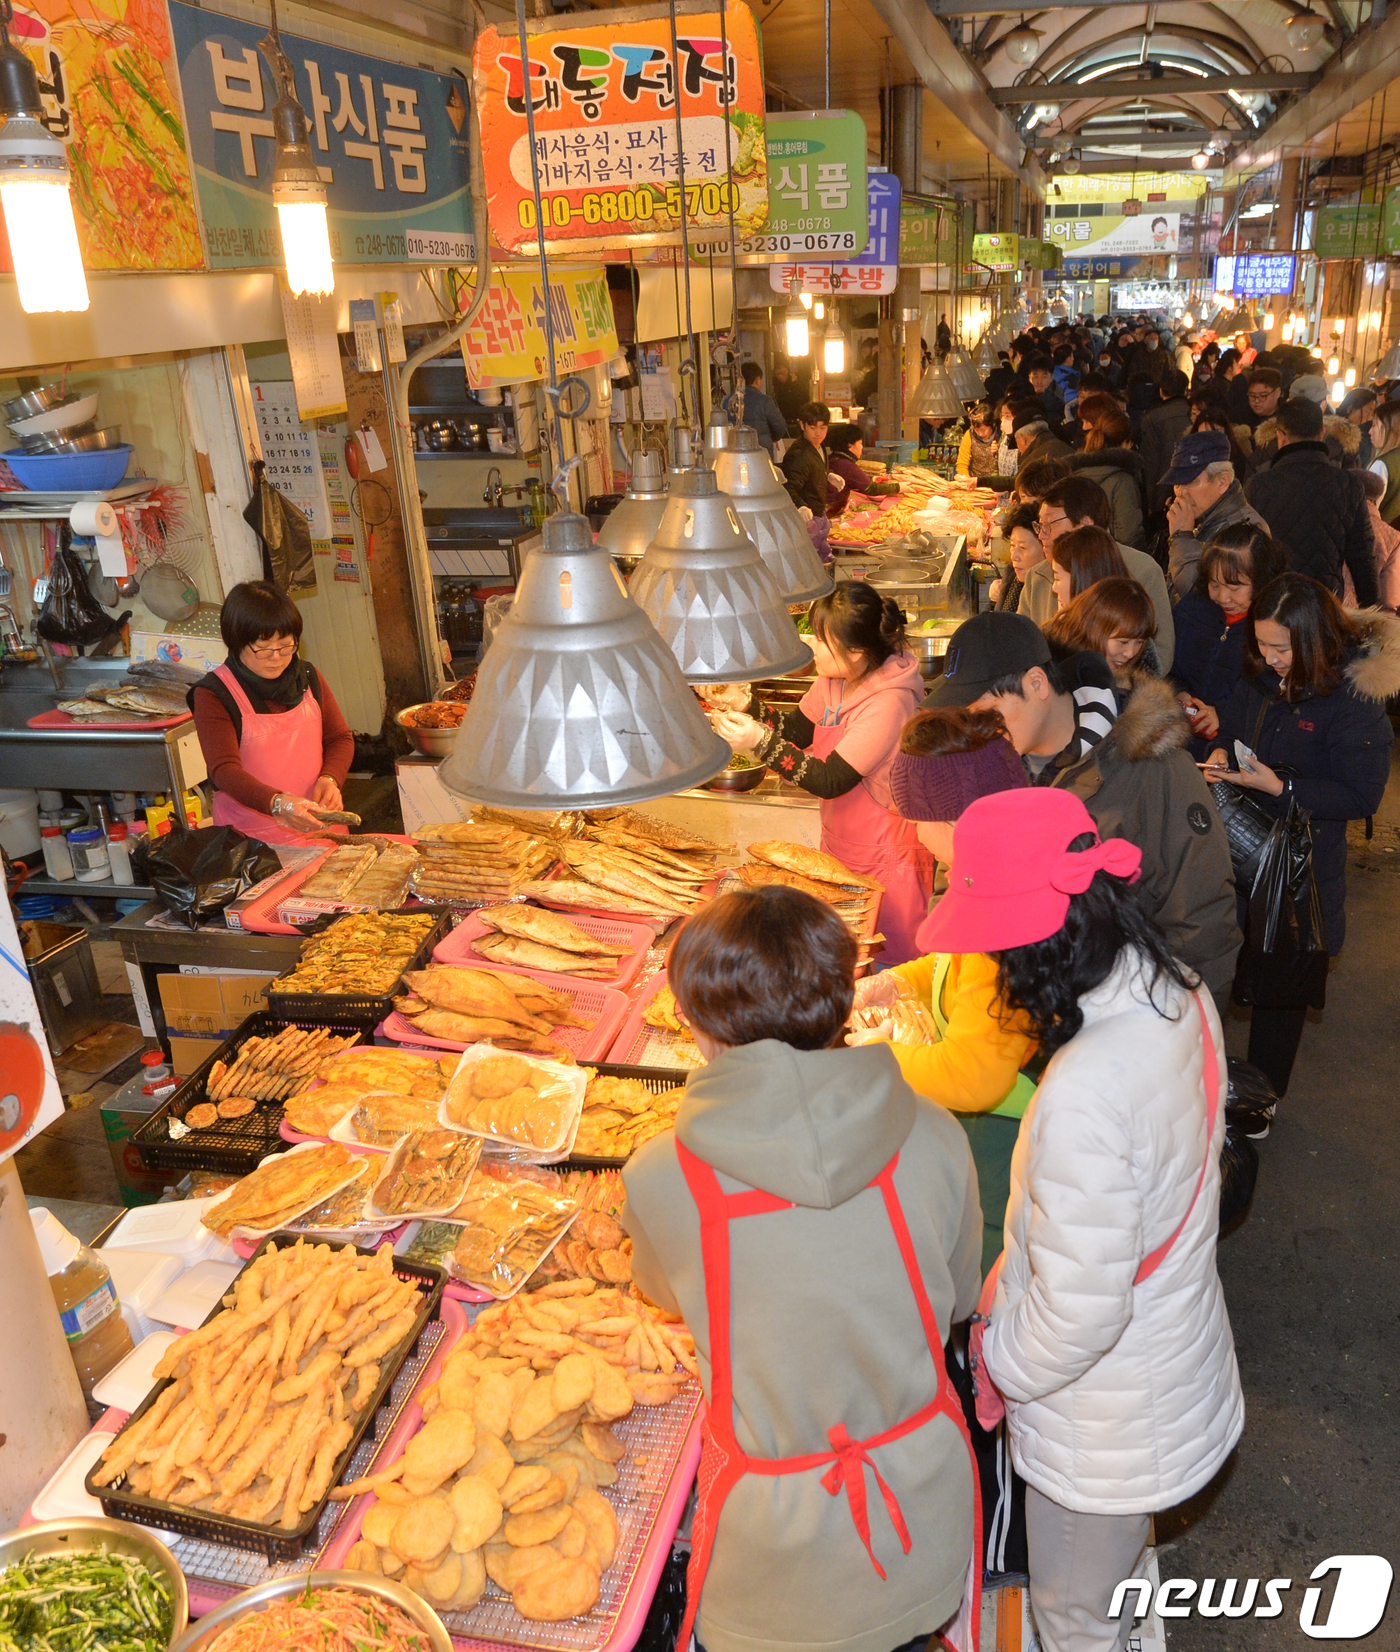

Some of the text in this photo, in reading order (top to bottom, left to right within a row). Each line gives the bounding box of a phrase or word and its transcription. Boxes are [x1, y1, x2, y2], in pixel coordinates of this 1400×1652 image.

[499, 38, 736, 119] 대동전집
[518, 183, 740, 228] 010-6800-5709
[408, 238, 475, 259] 010-5230-0678
[781, 266, 886, 291] 칼국수방
[255, 386, 264, 401] 1
